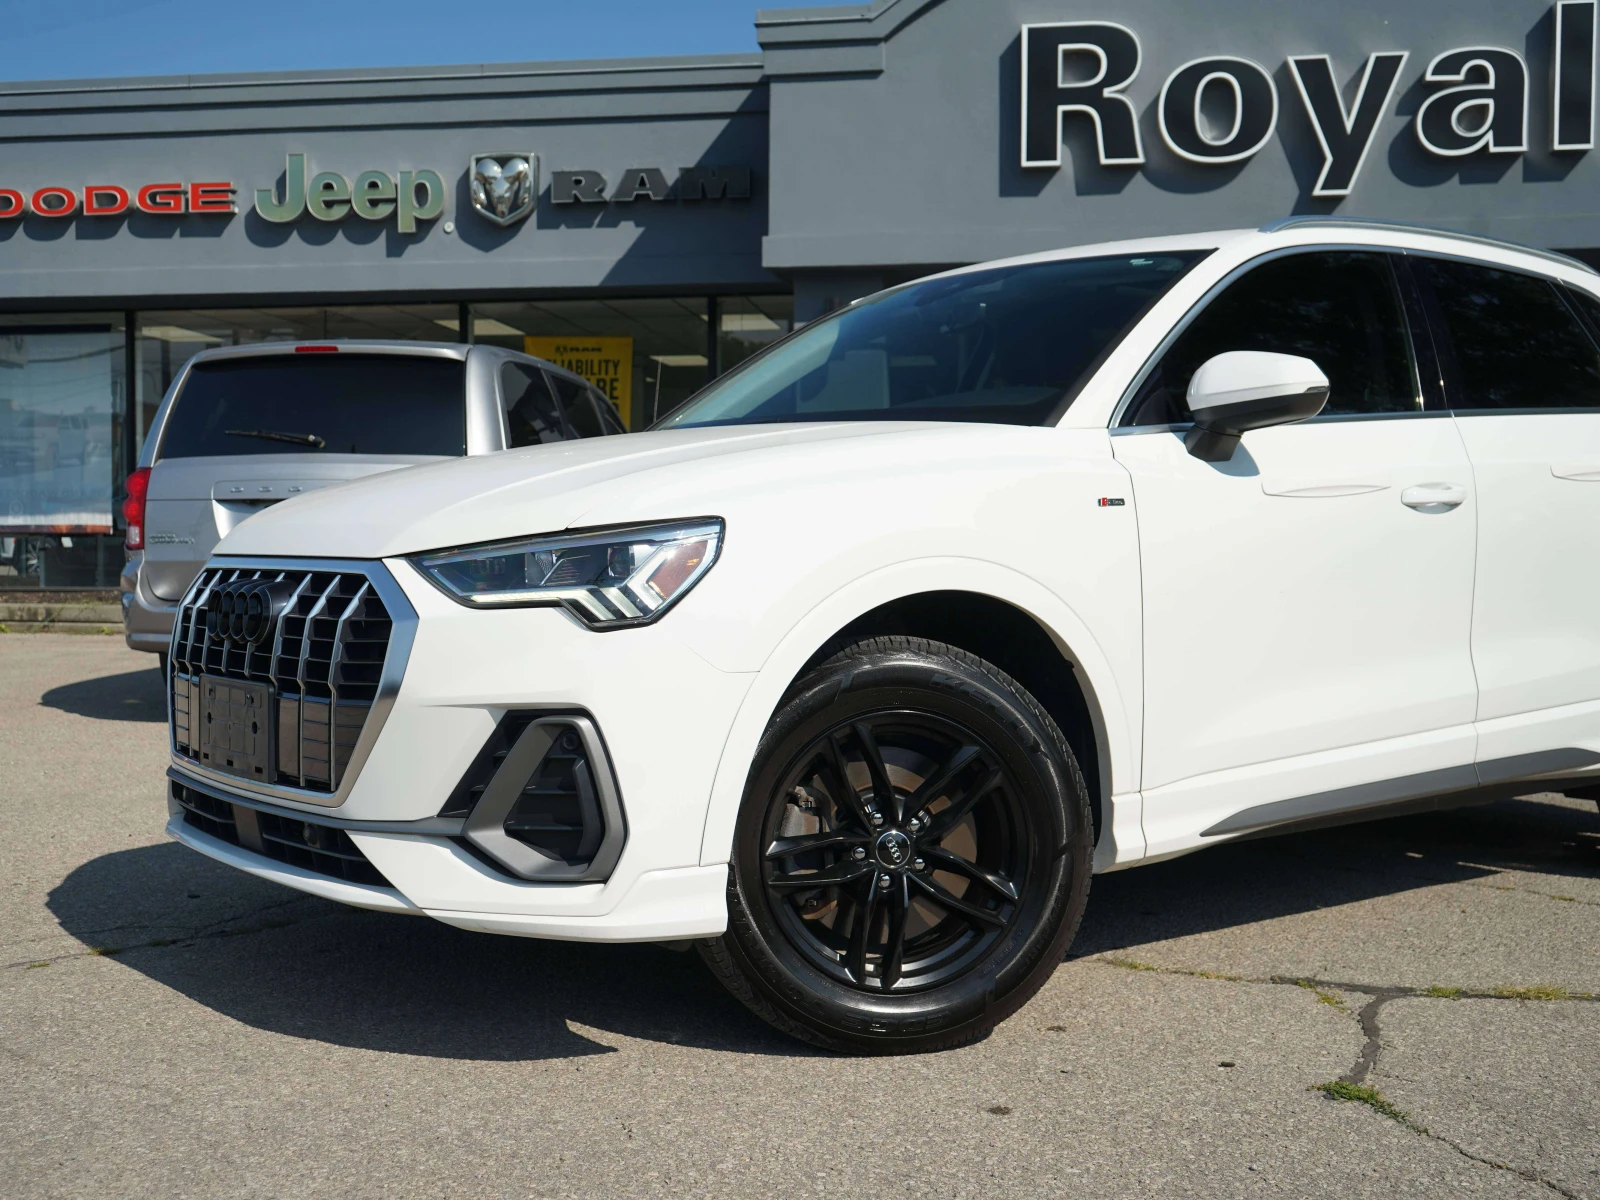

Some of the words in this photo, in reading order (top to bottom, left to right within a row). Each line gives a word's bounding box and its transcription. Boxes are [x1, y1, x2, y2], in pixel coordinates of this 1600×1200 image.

[1020, 0, 1599, 197] Royal
[254, 153, 445, 232] Jeep
[551, 166, 752, 204] RAM
[841, 1010, 951, 1033] EDGE
